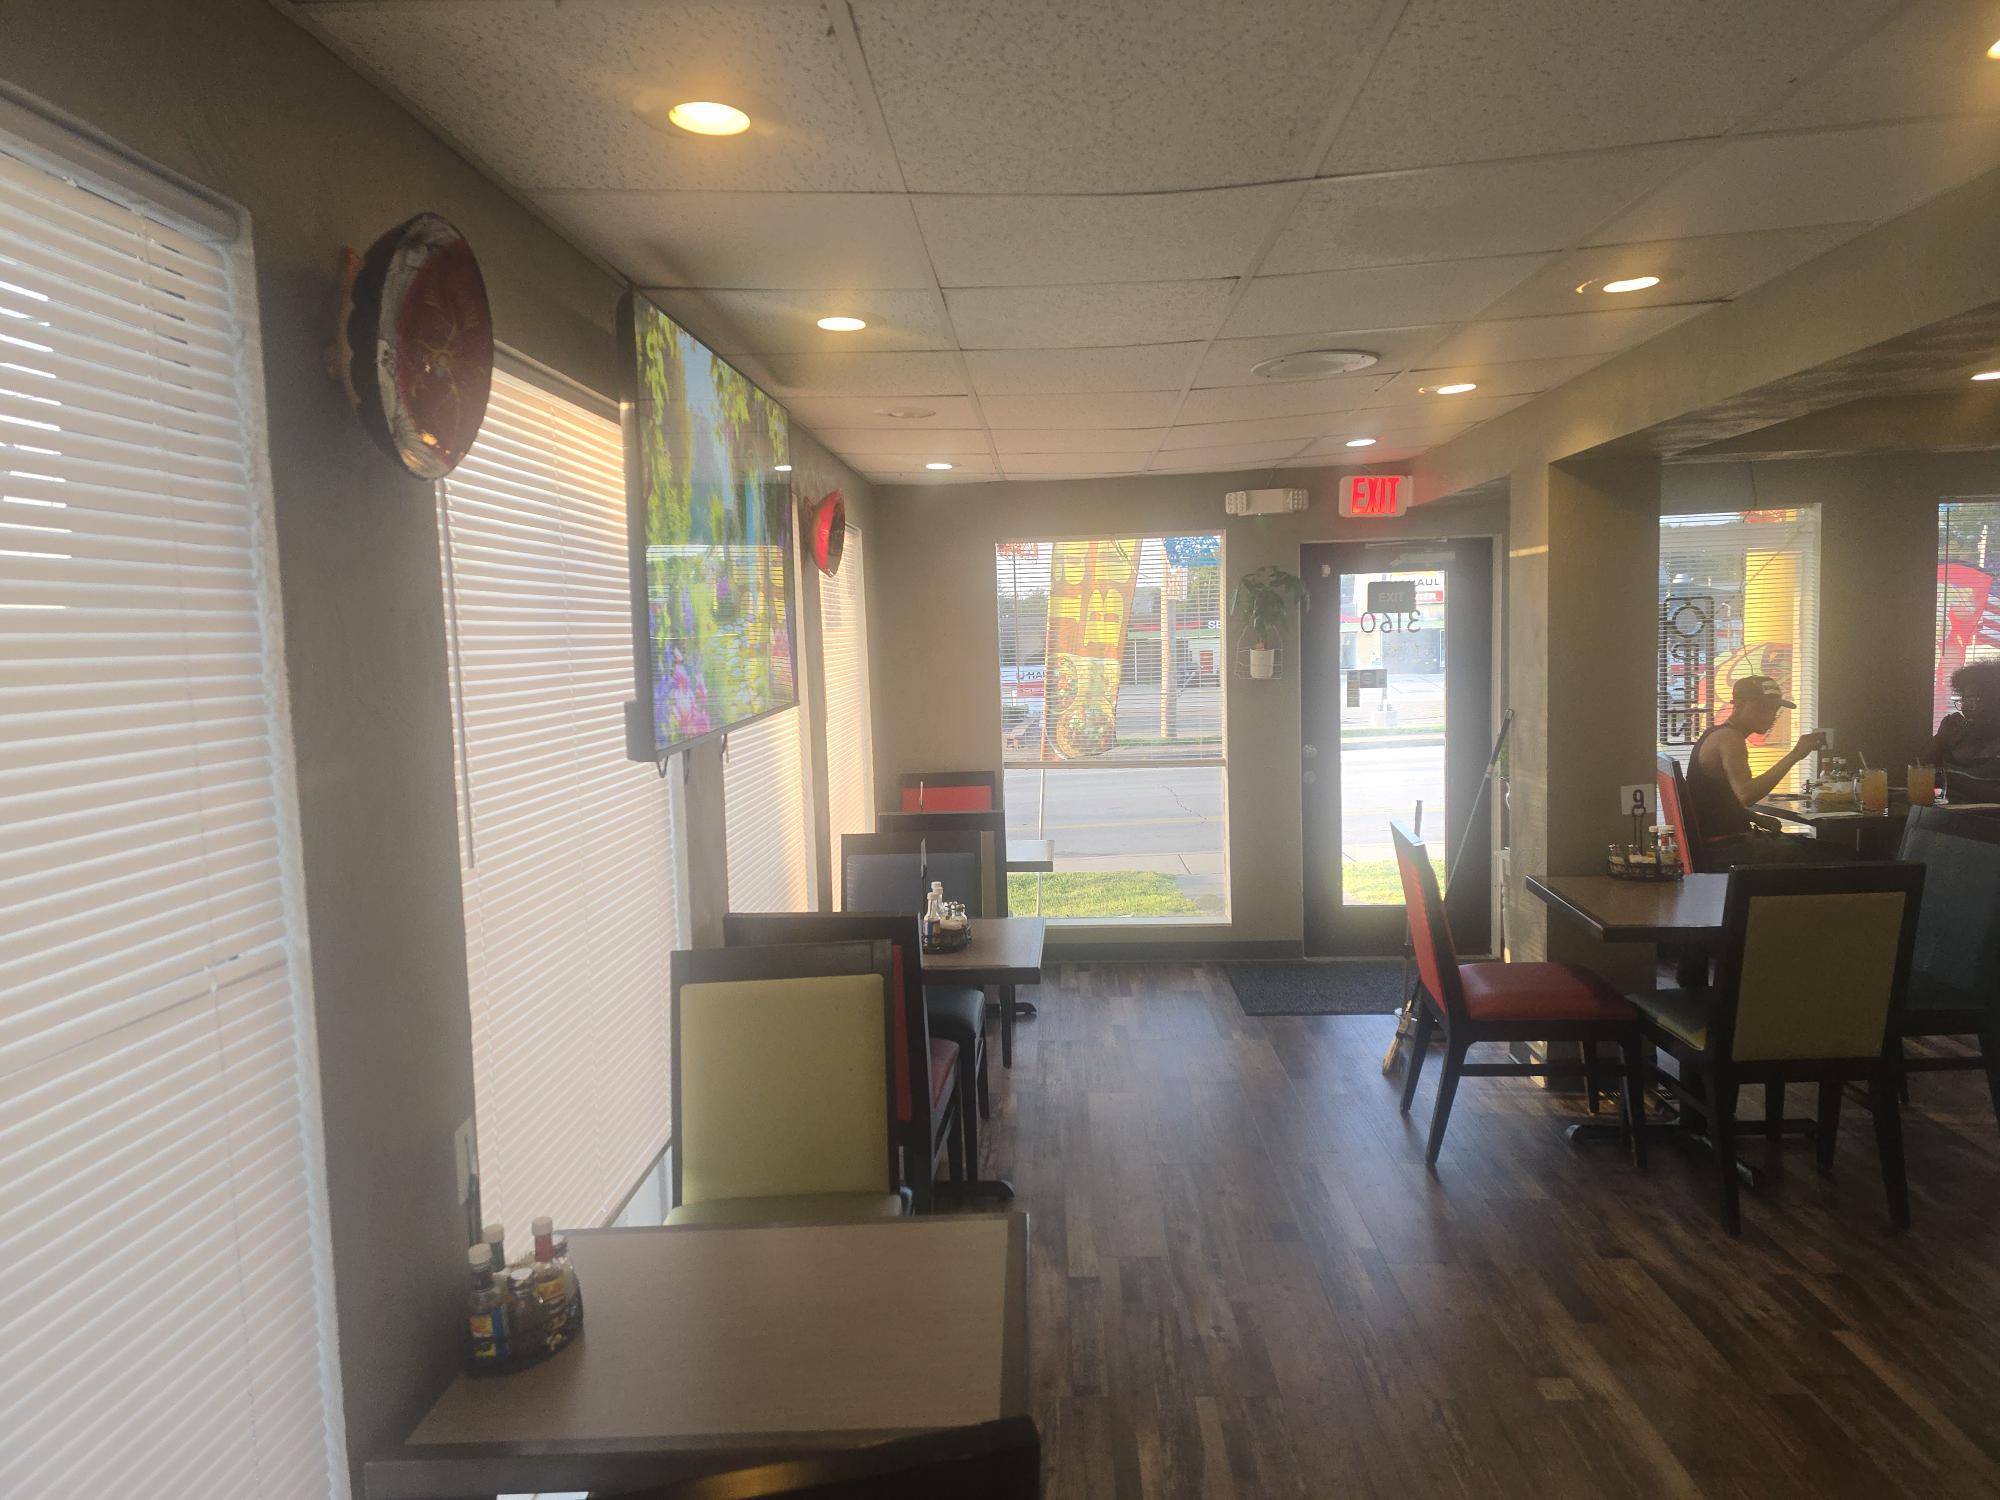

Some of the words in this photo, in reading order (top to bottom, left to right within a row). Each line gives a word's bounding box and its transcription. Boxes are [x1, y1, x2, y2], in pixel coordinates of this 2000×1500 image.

[1352, 476, 1401, 514] EXIT
[1378, 591, 1405, 602] EXIT
[1632, 789, 1645, 809] 9
